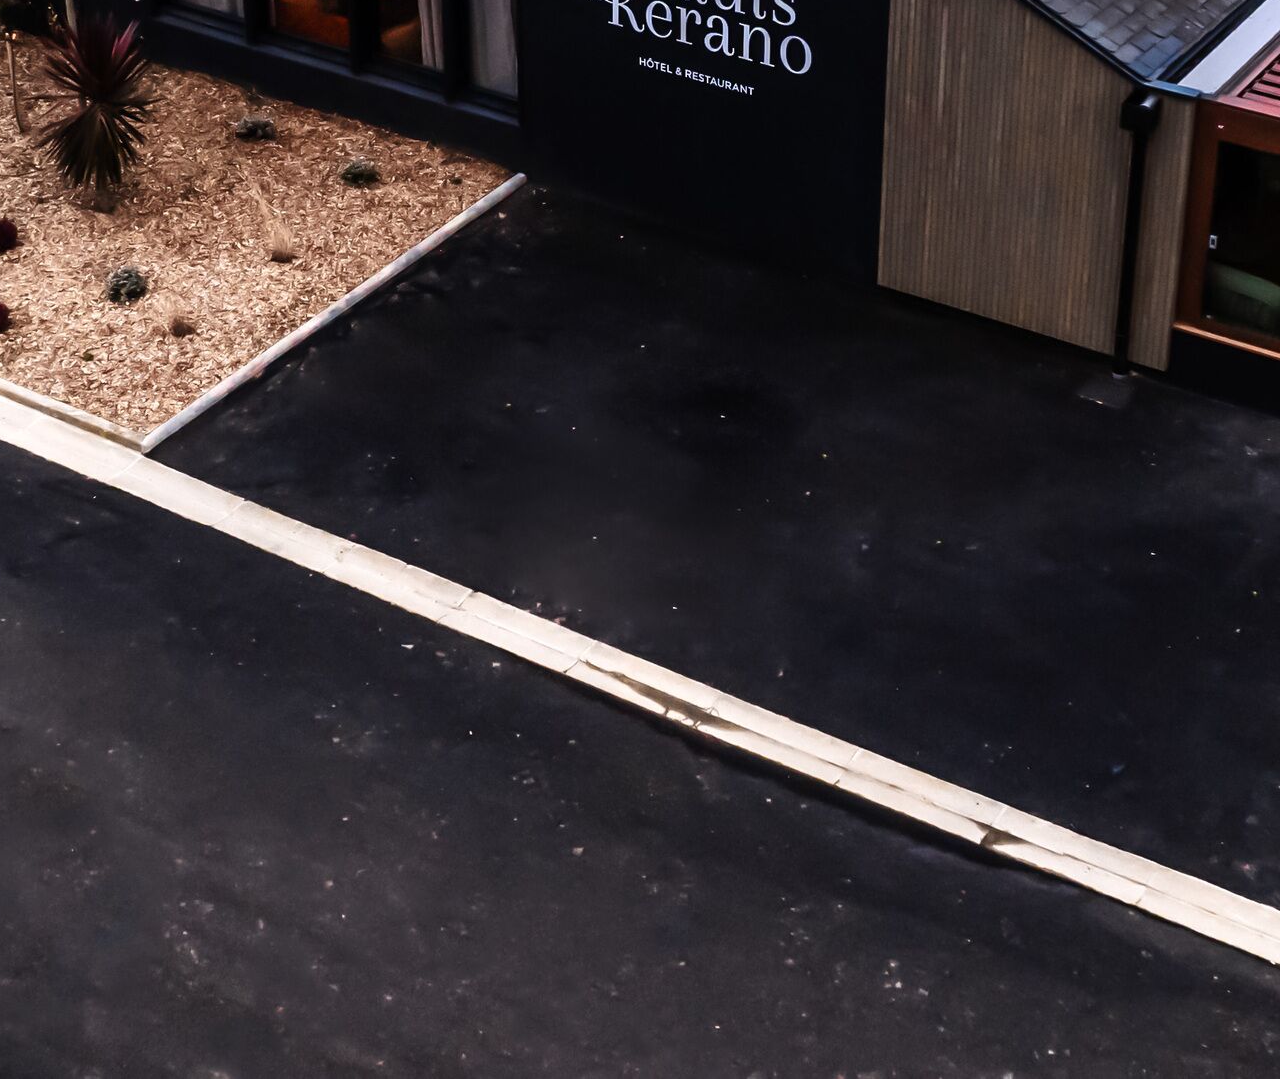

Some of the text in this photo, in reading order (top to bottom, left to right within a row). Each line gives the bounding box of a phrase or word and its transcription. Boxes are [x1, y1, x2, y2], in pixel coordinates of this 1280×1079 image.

[638, 56, 755, 96] HÔTEL & RESTAURANT
